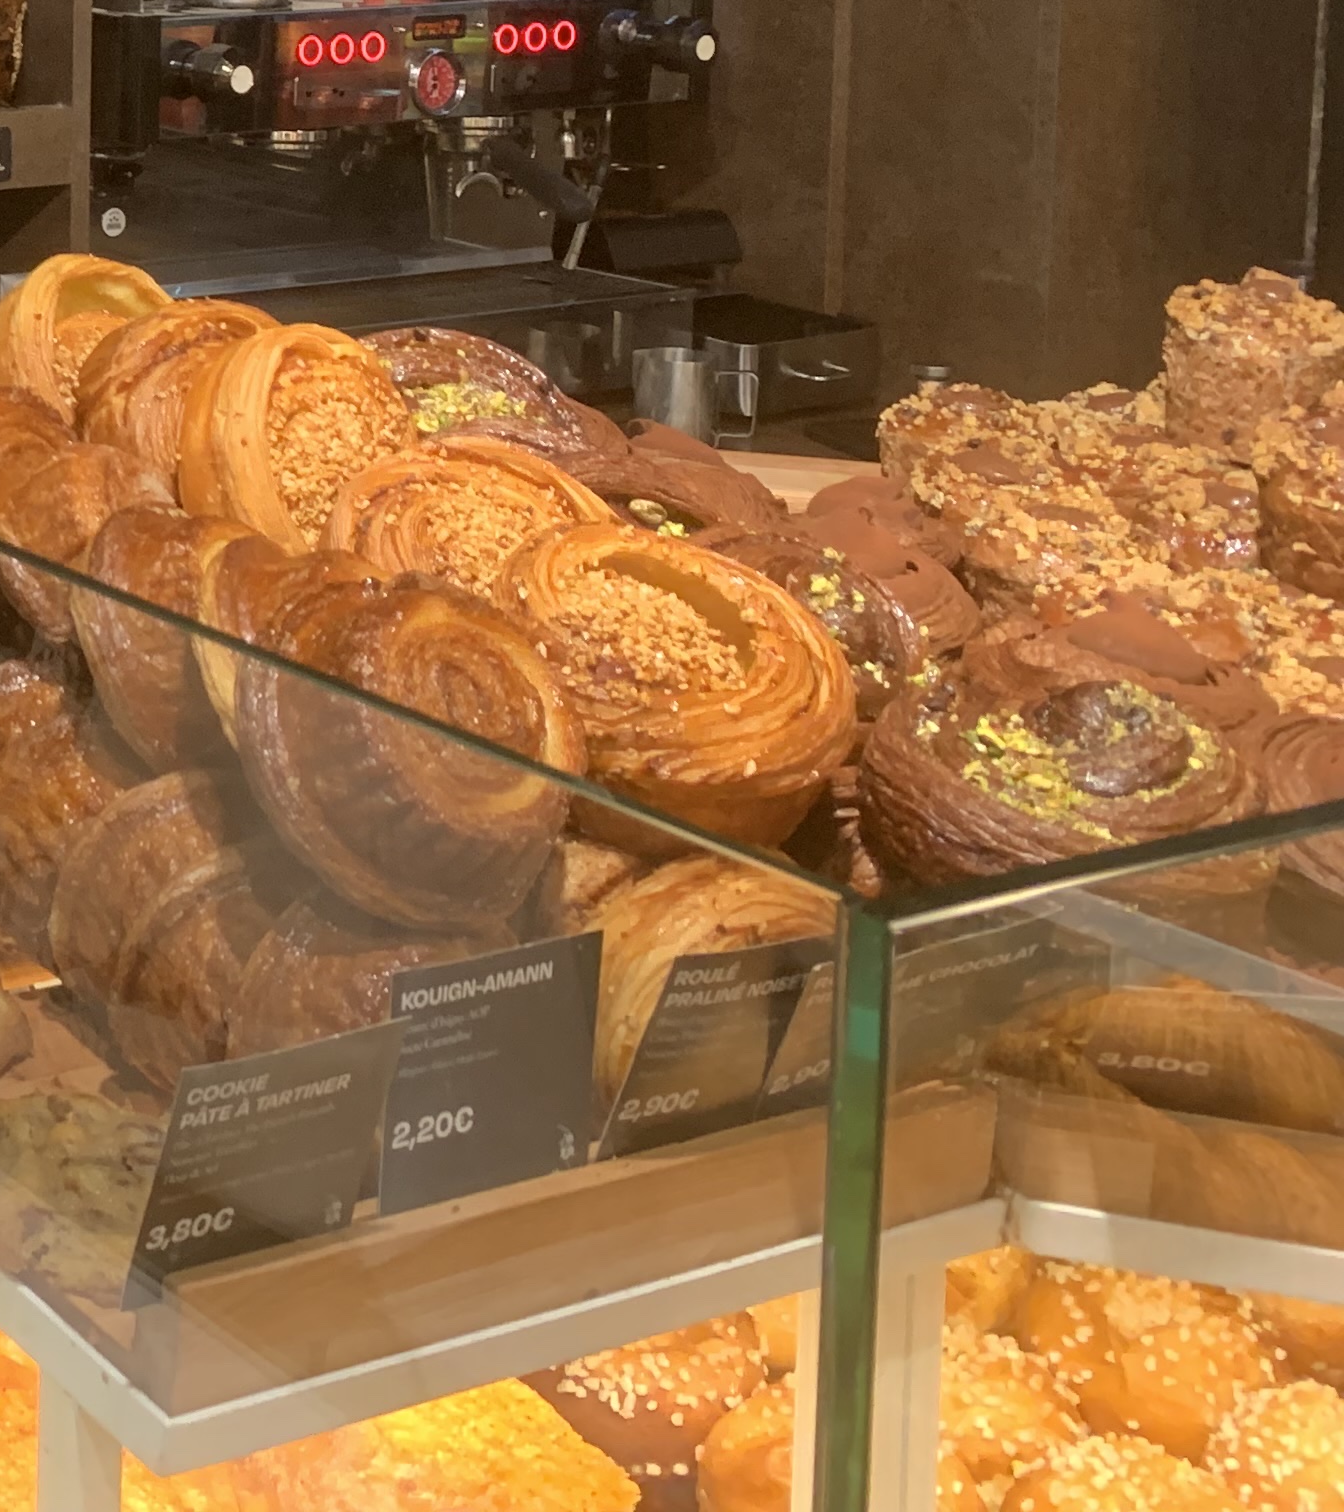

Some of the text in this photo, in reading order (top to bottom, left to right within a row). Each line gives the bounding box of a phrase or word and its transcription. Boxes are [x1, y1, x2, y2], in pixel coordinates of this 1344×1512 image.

[401, 960, 554, 1011] KOUIGN-AMANN
[180, 1104, 234, 1130] PÂTE
[256, 1073, 352, 1112] TARTINER
[186, 1073, 270, 1106] COOKIE
